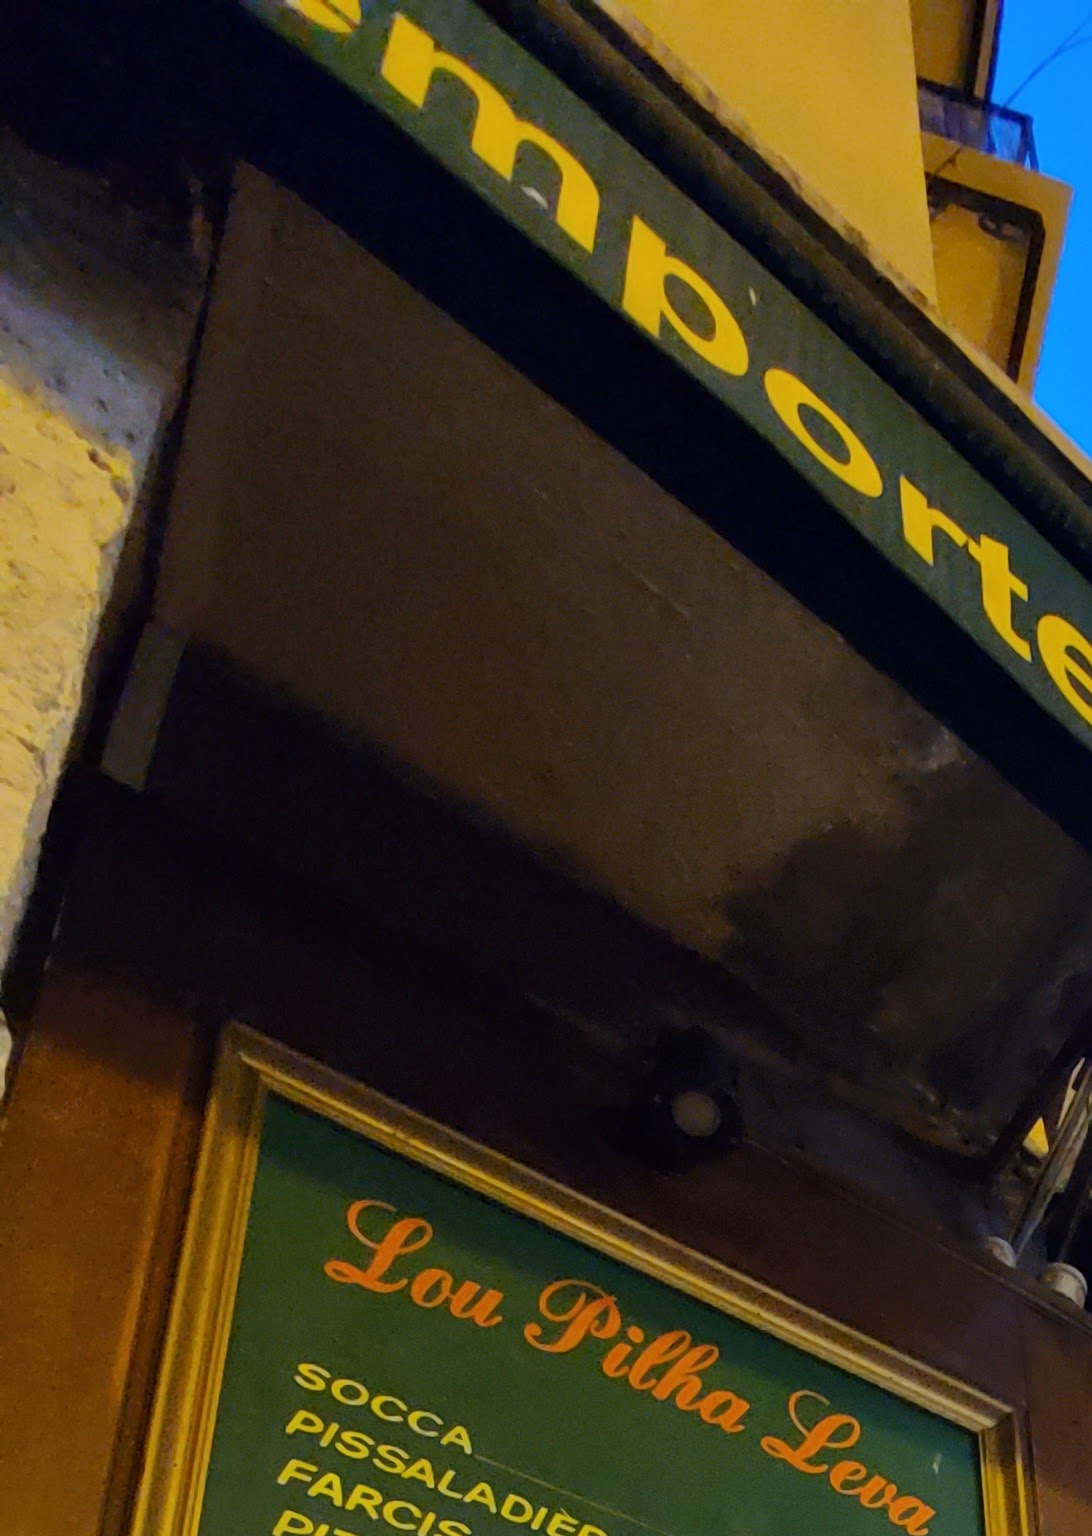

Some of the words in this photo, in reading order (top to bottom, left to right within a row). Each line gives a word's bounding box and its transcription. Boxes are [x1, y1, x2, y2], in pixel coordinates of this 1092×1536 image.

[324, 1199, 503, 1330] Lou
[523, 1279, 746, 1435] Pilha
[293, 1362, 473, 1456] SOCCA
